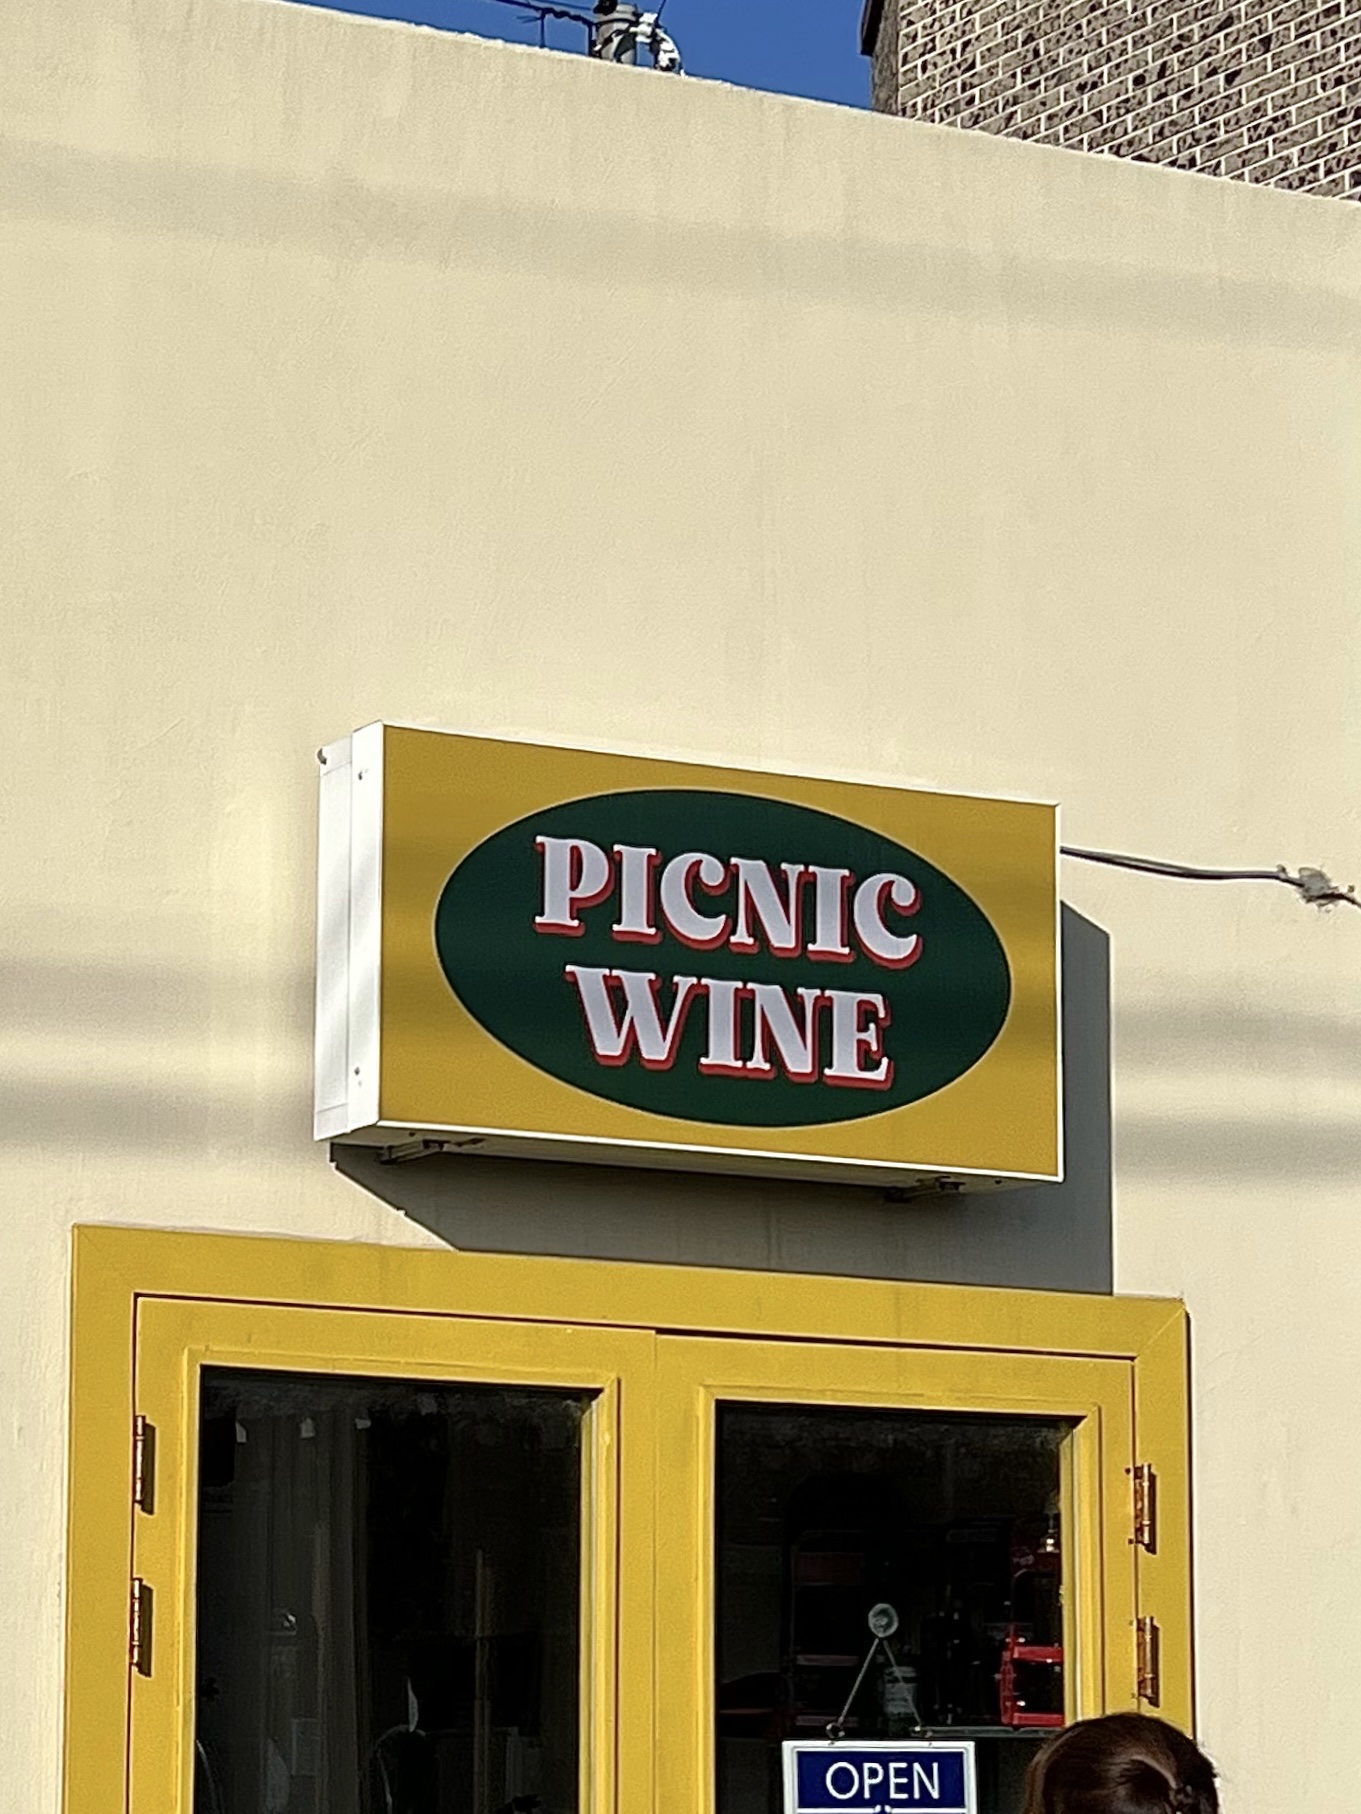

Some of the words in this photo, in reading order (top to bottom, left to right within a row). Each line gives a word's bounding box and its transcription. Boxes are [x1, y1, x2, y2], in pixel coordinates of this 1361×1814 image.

[535, 835, 923, 968] PICNIC
[565, 964, 893, 1090] WINE
[826, 1761, 940, 1800] OPEN
